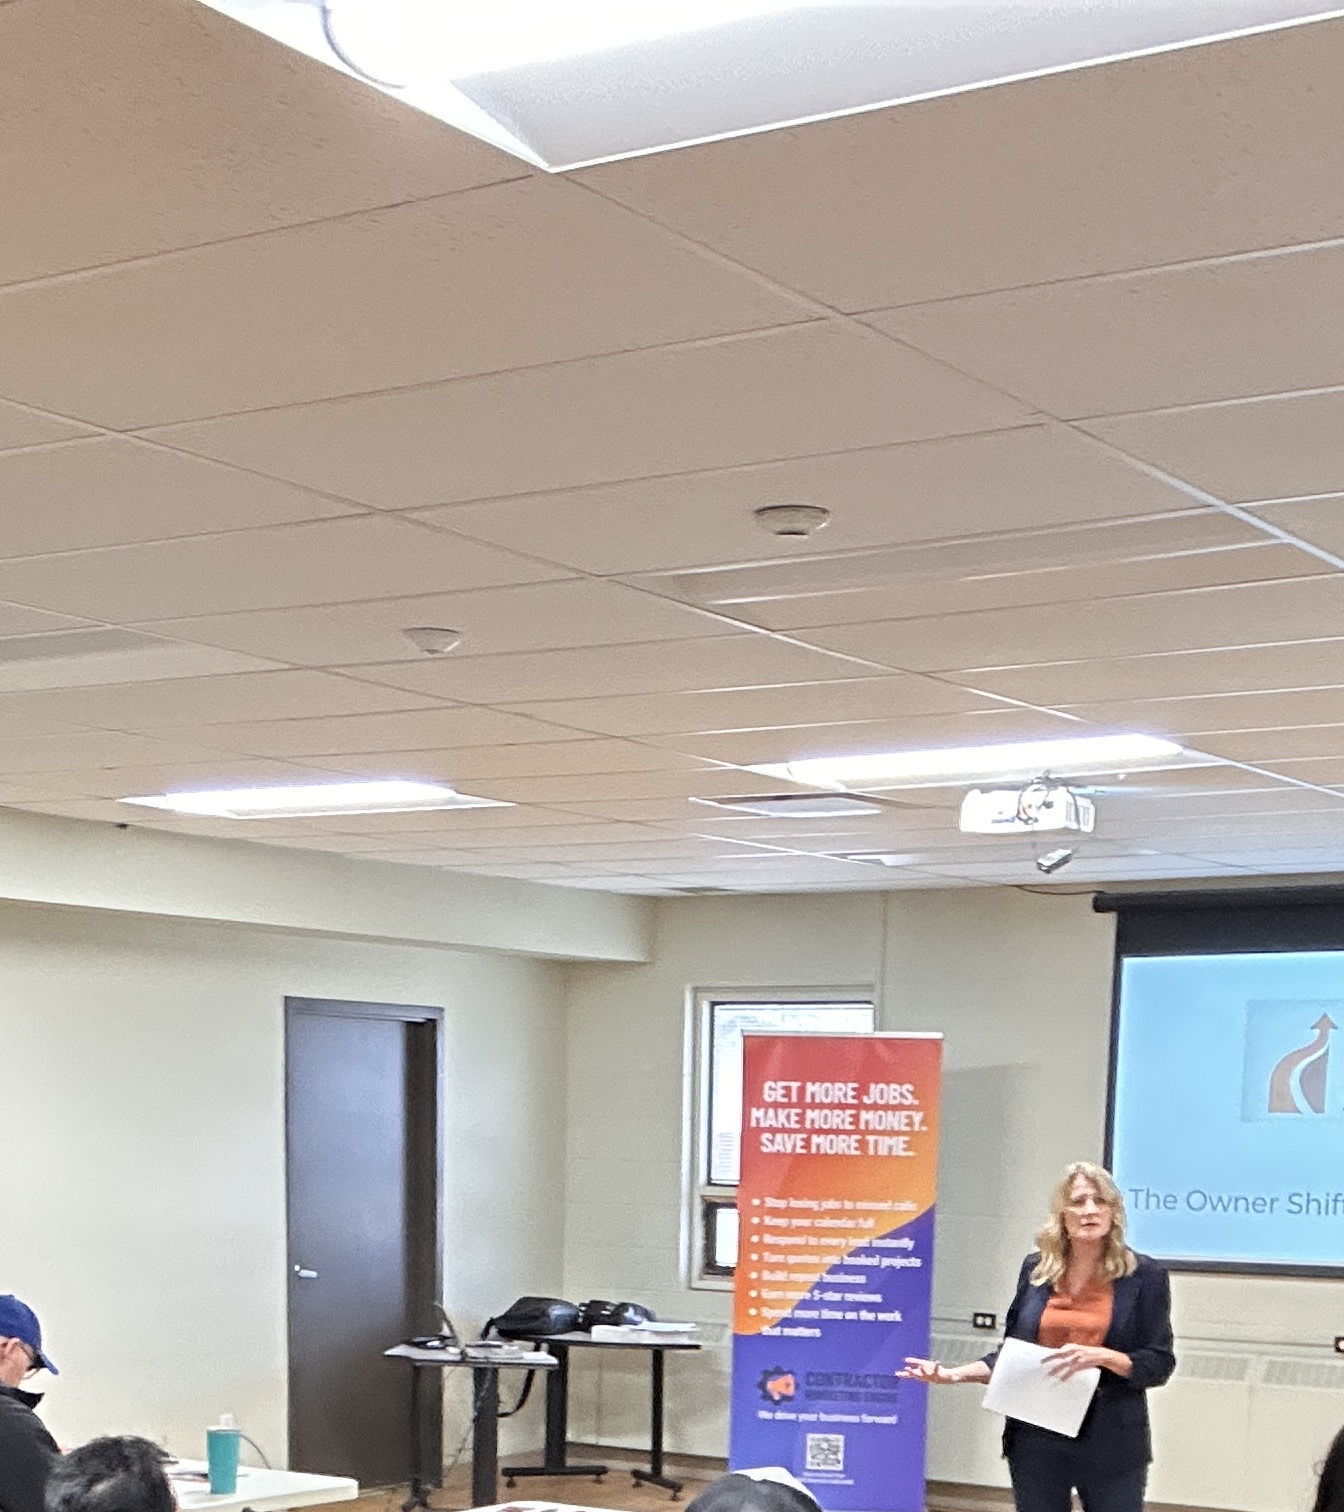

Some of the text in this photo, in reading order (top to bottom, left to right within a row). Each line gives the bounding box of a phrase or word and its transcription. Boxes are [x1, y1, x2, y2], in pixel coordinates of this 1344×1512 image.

[763, 1081, 919, 1105] GET MORE JOBS.
[751, 1108, 927, 1131] MAKE MORE MONEY.
[761, 1134, 915, 1156] SAVE MORE TIME.
[1130, 1189, 1178, 1211] The
[1186, 1190, 1279, 1215] Owner
